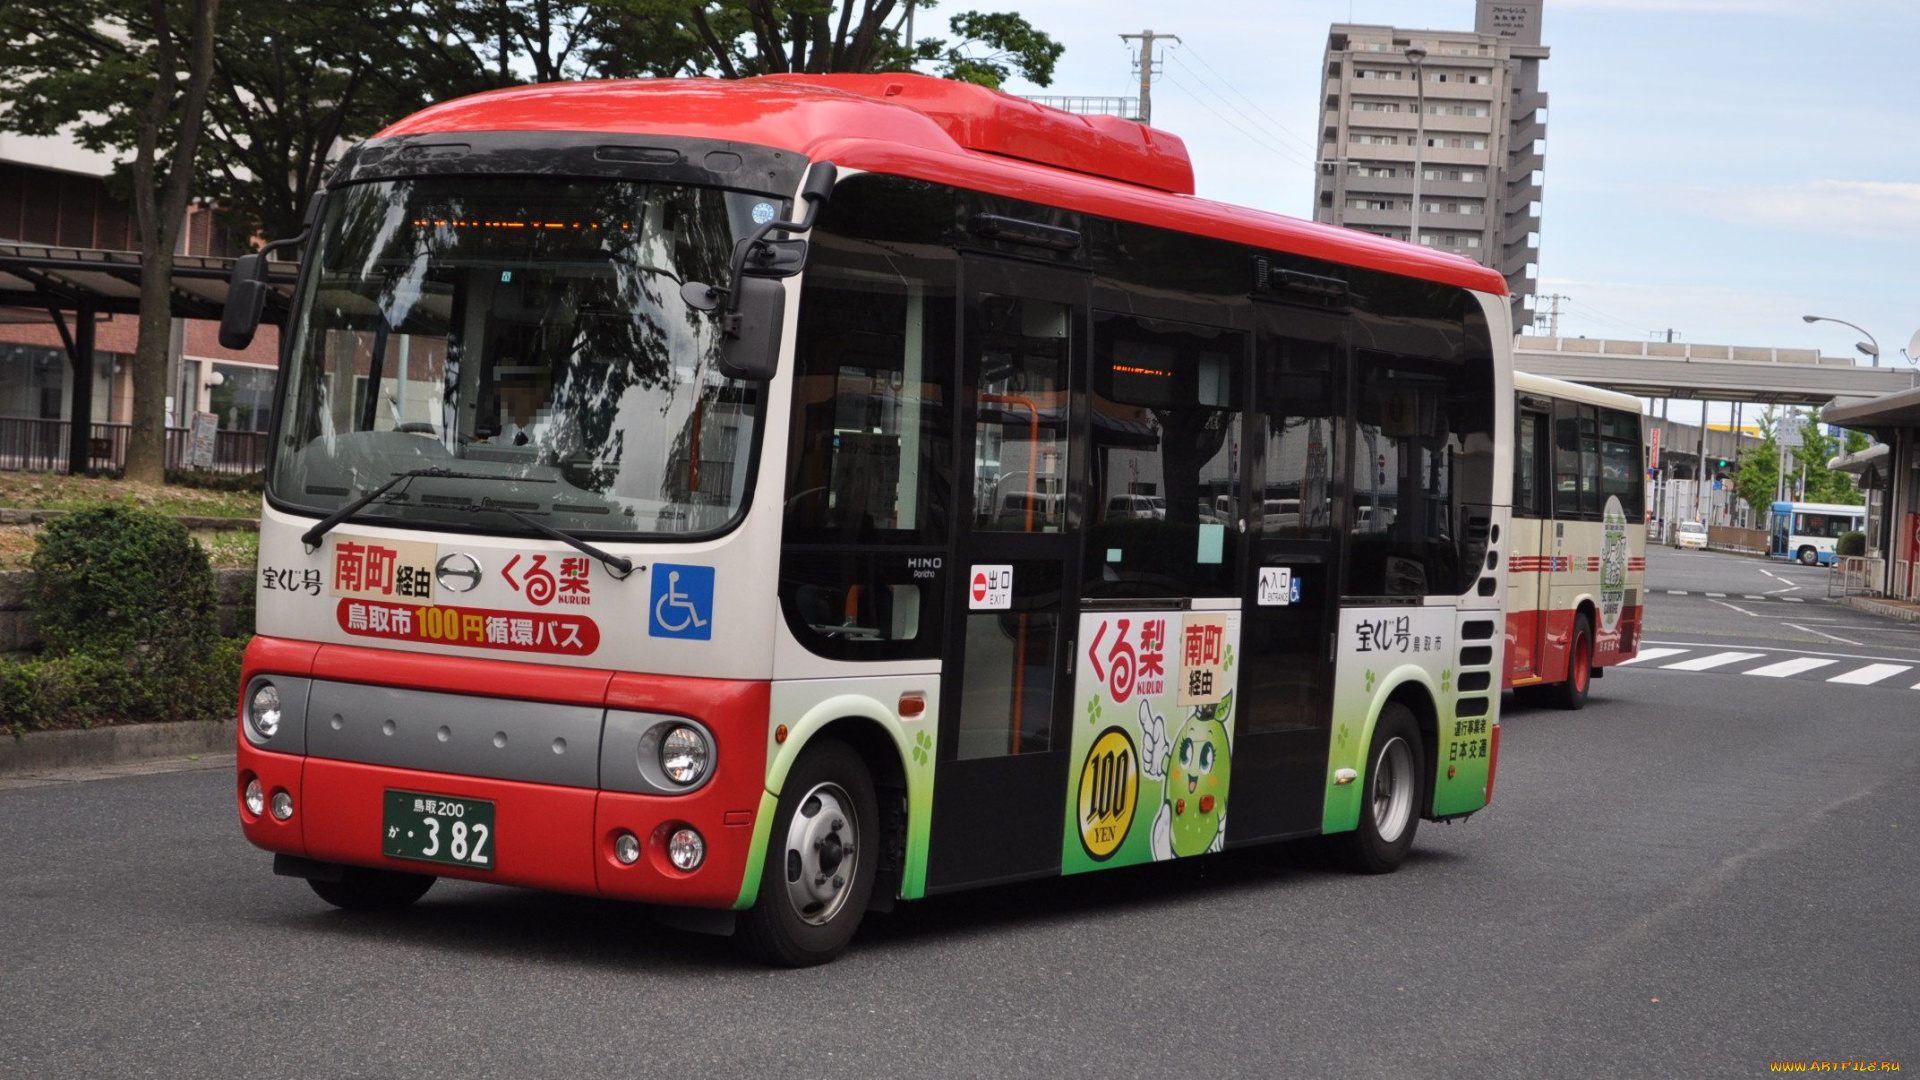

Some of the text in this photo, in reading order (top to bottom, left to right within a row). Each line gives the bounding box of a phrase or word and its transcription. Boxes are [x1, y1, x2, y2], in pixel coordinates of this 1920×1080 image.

[908, 558, 942, 568] HINO
[262, 566, 323, 596] 宝くじ号
[501, 554, 591, 606] くる梨
[988, 570, 1010, 590] 出口
[1270, 572, 1287, 589] 入口
[558, 594, 591, 606] KURURI
[989, 594, 1006, 605] EXIT
[1184, 624, 1223, 666] 南町
[1356, 615, 1442, 653] 宝くじ号 鳥取市
[1088, 618, 1166, 703] くる梨
[1136, 680, 1164, 695] KURURI
[1187, 669, 1213, 697] 経由
[1450, 738, 1487, 761] 日本交通
[1086, 748, 1128, 824] 100
[1094, 825, 1116, 844] YEN
